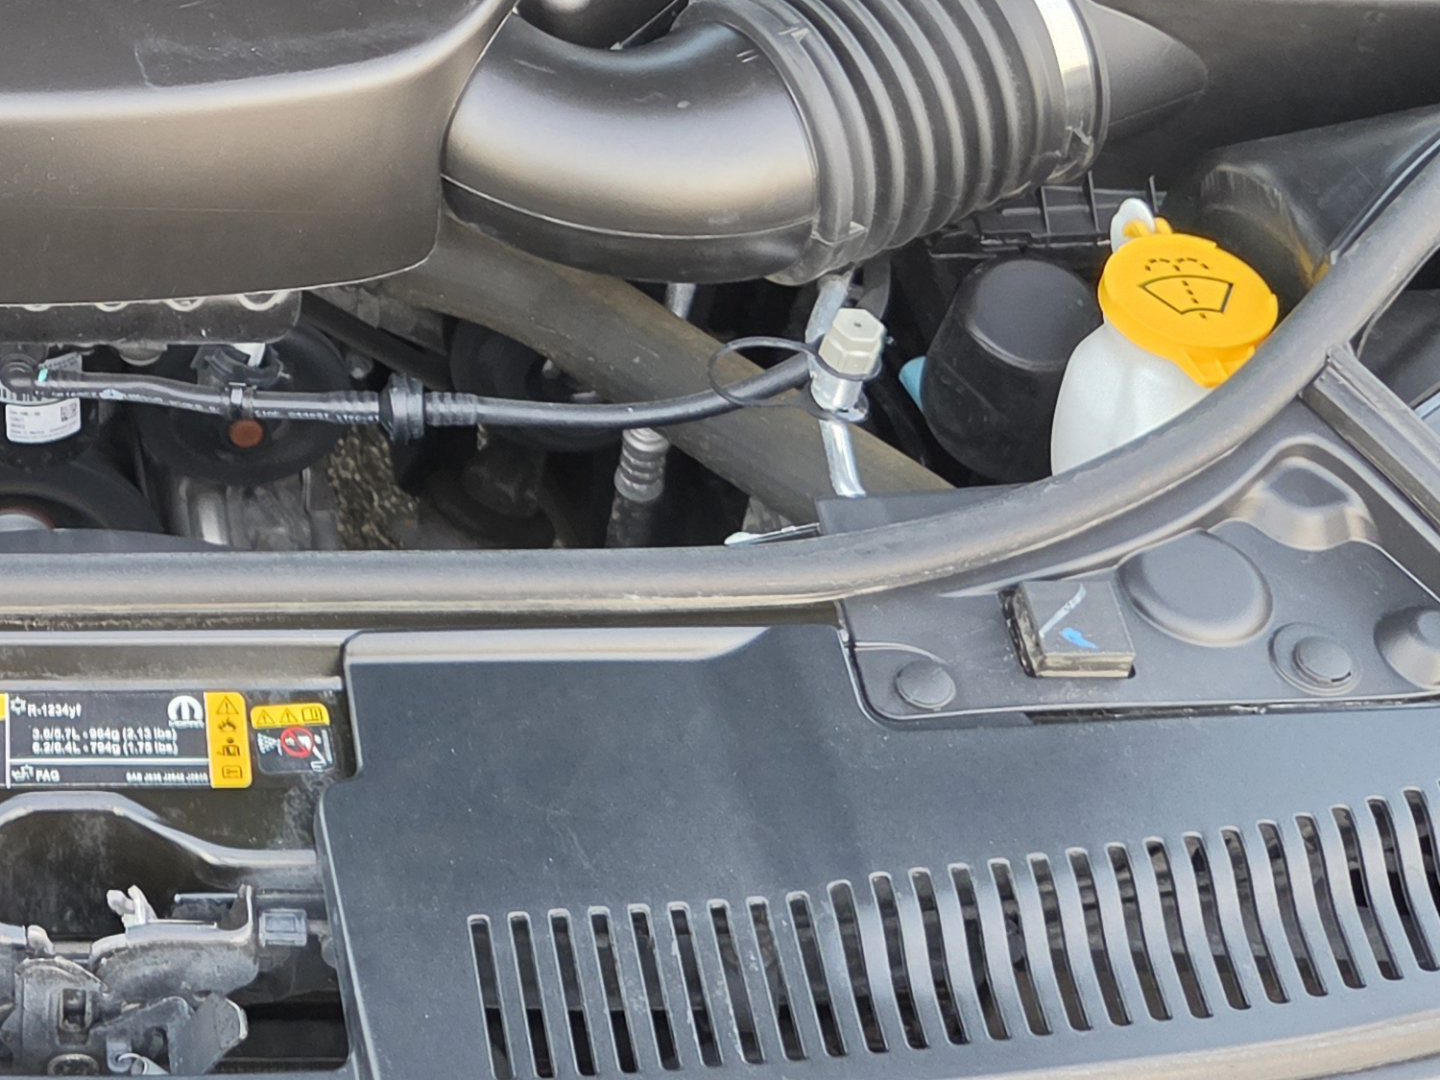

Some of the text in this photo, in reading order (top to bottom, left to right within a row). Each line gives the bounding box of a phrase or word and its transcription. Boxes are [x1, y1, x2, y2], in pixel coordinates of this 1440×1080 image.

[28, 703, 82, 719] R-1234yf
[154, 726, 178, 741] lbs)
[154, 741, 179, 756] lbs)
[35, 770, 60, 783] PAG
